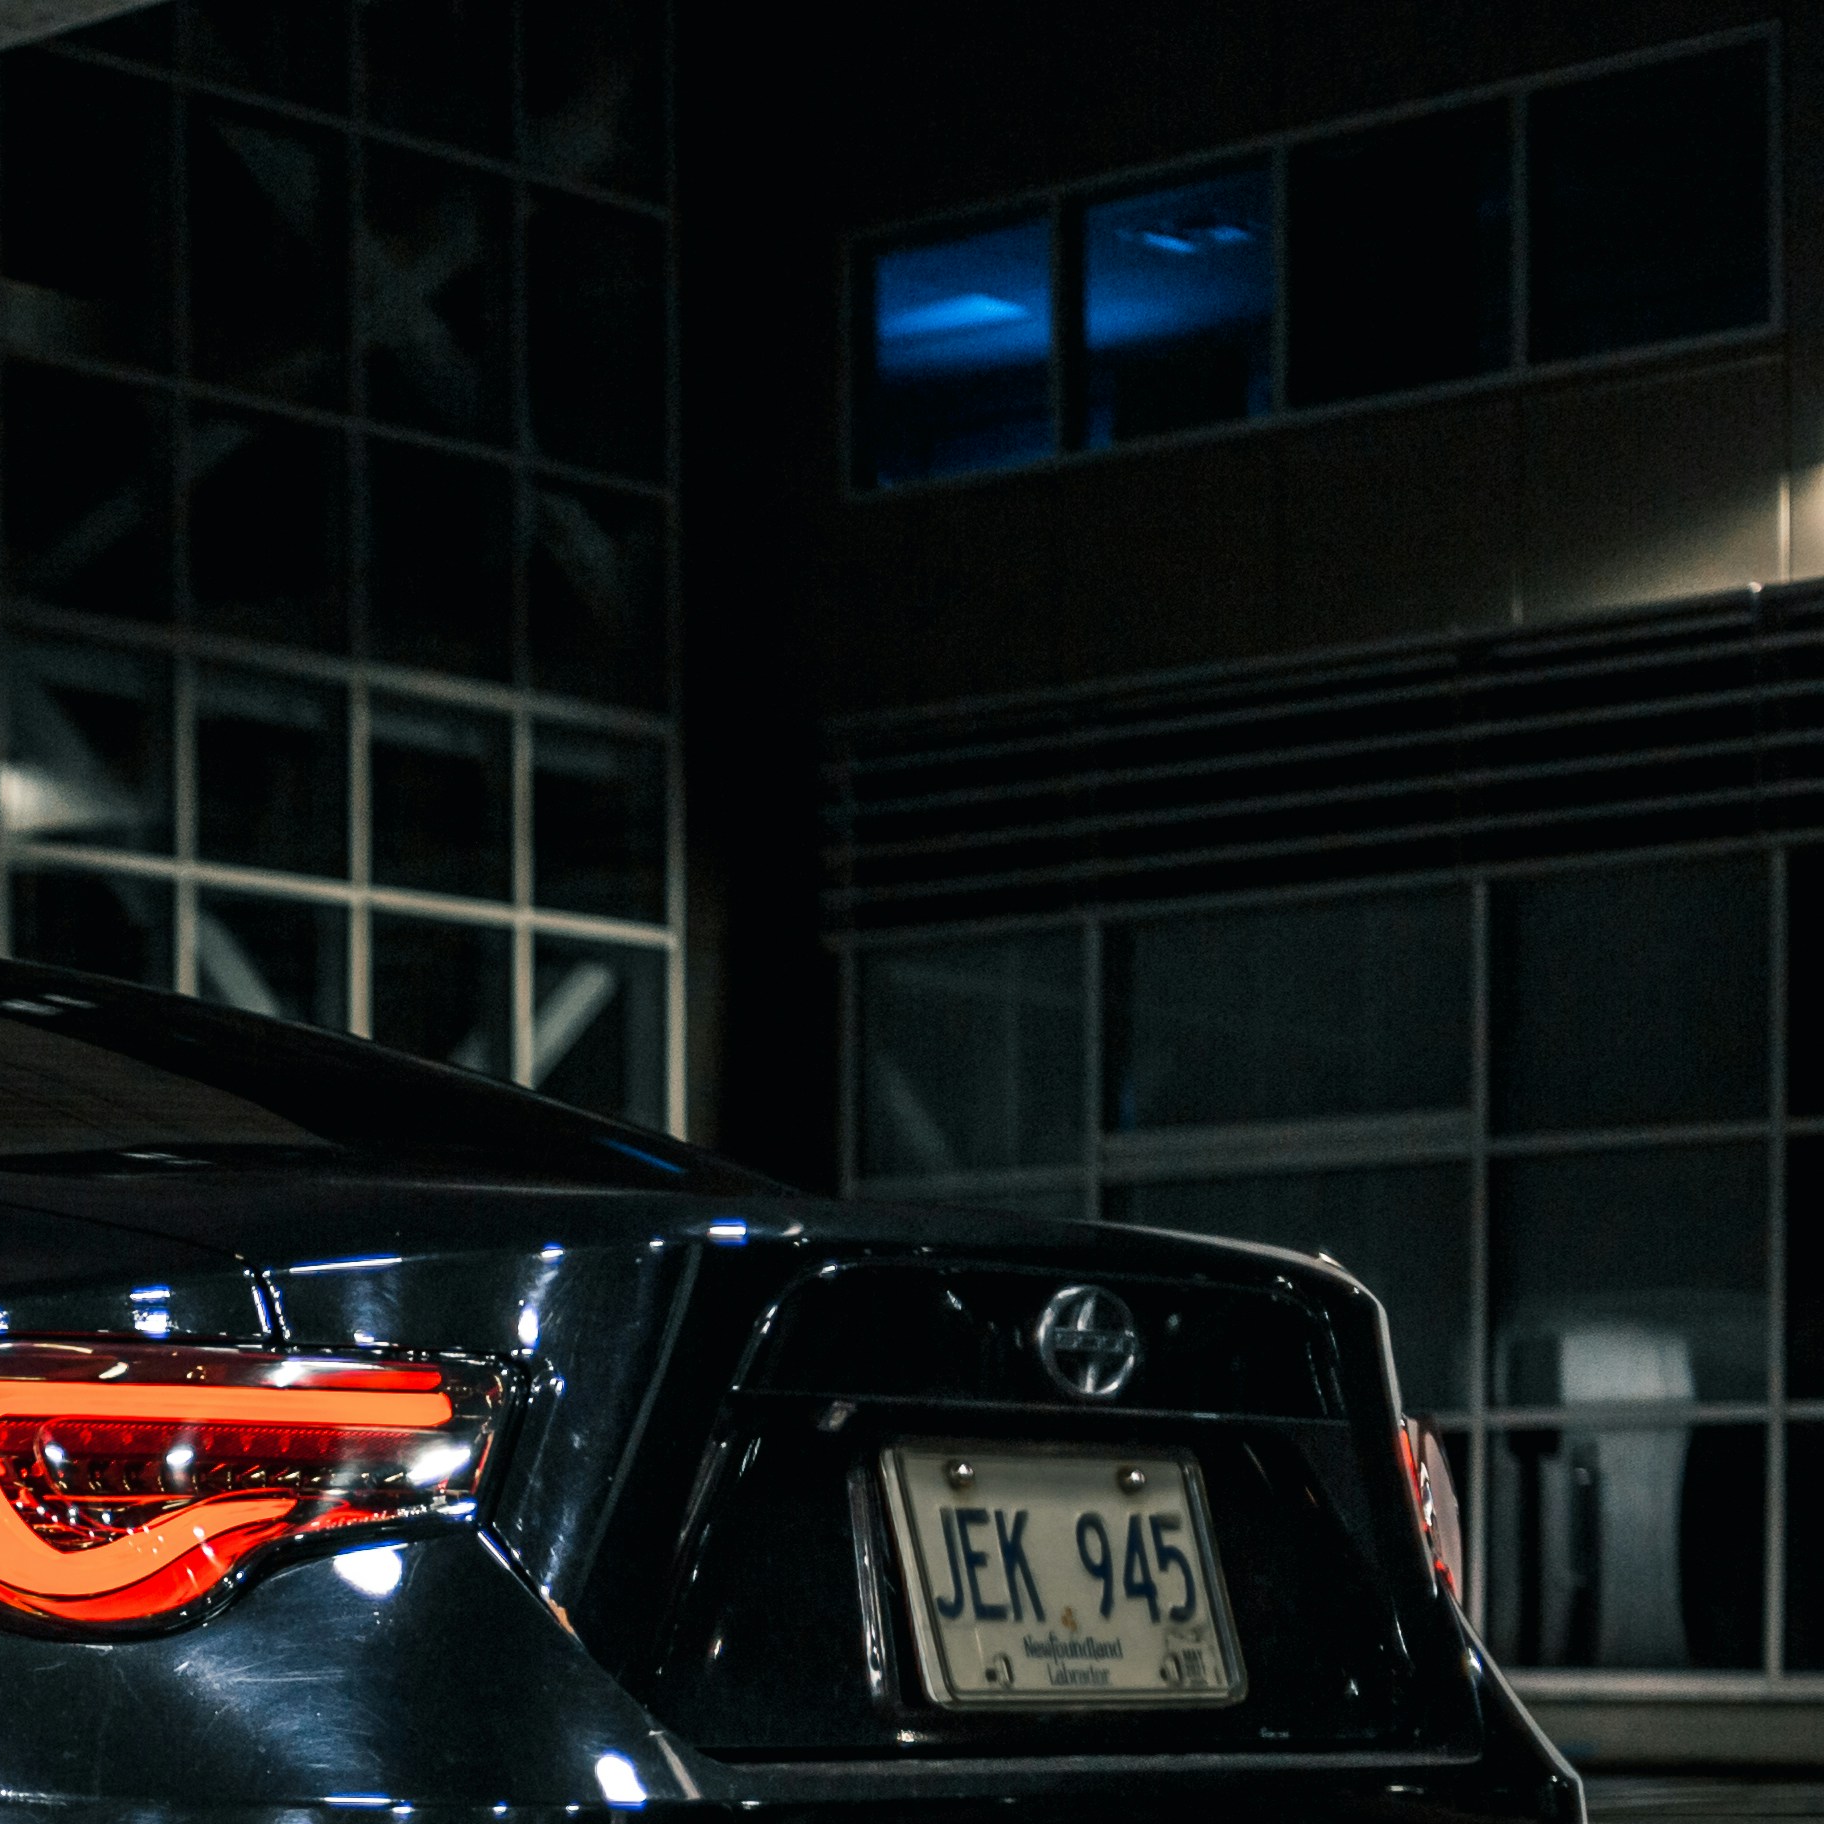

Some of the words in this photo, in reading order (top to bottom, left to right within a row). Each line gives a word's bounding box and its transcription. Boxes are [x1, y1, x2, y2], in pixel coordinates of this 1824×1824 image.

[935, 1507, 1046, 1622] JEK
[1075, 1511, 1196, 1623] 945
[1023, 1631, 1124, 1666] Newfoundland
[1047, 1661, 1110, 1686] Labrador
